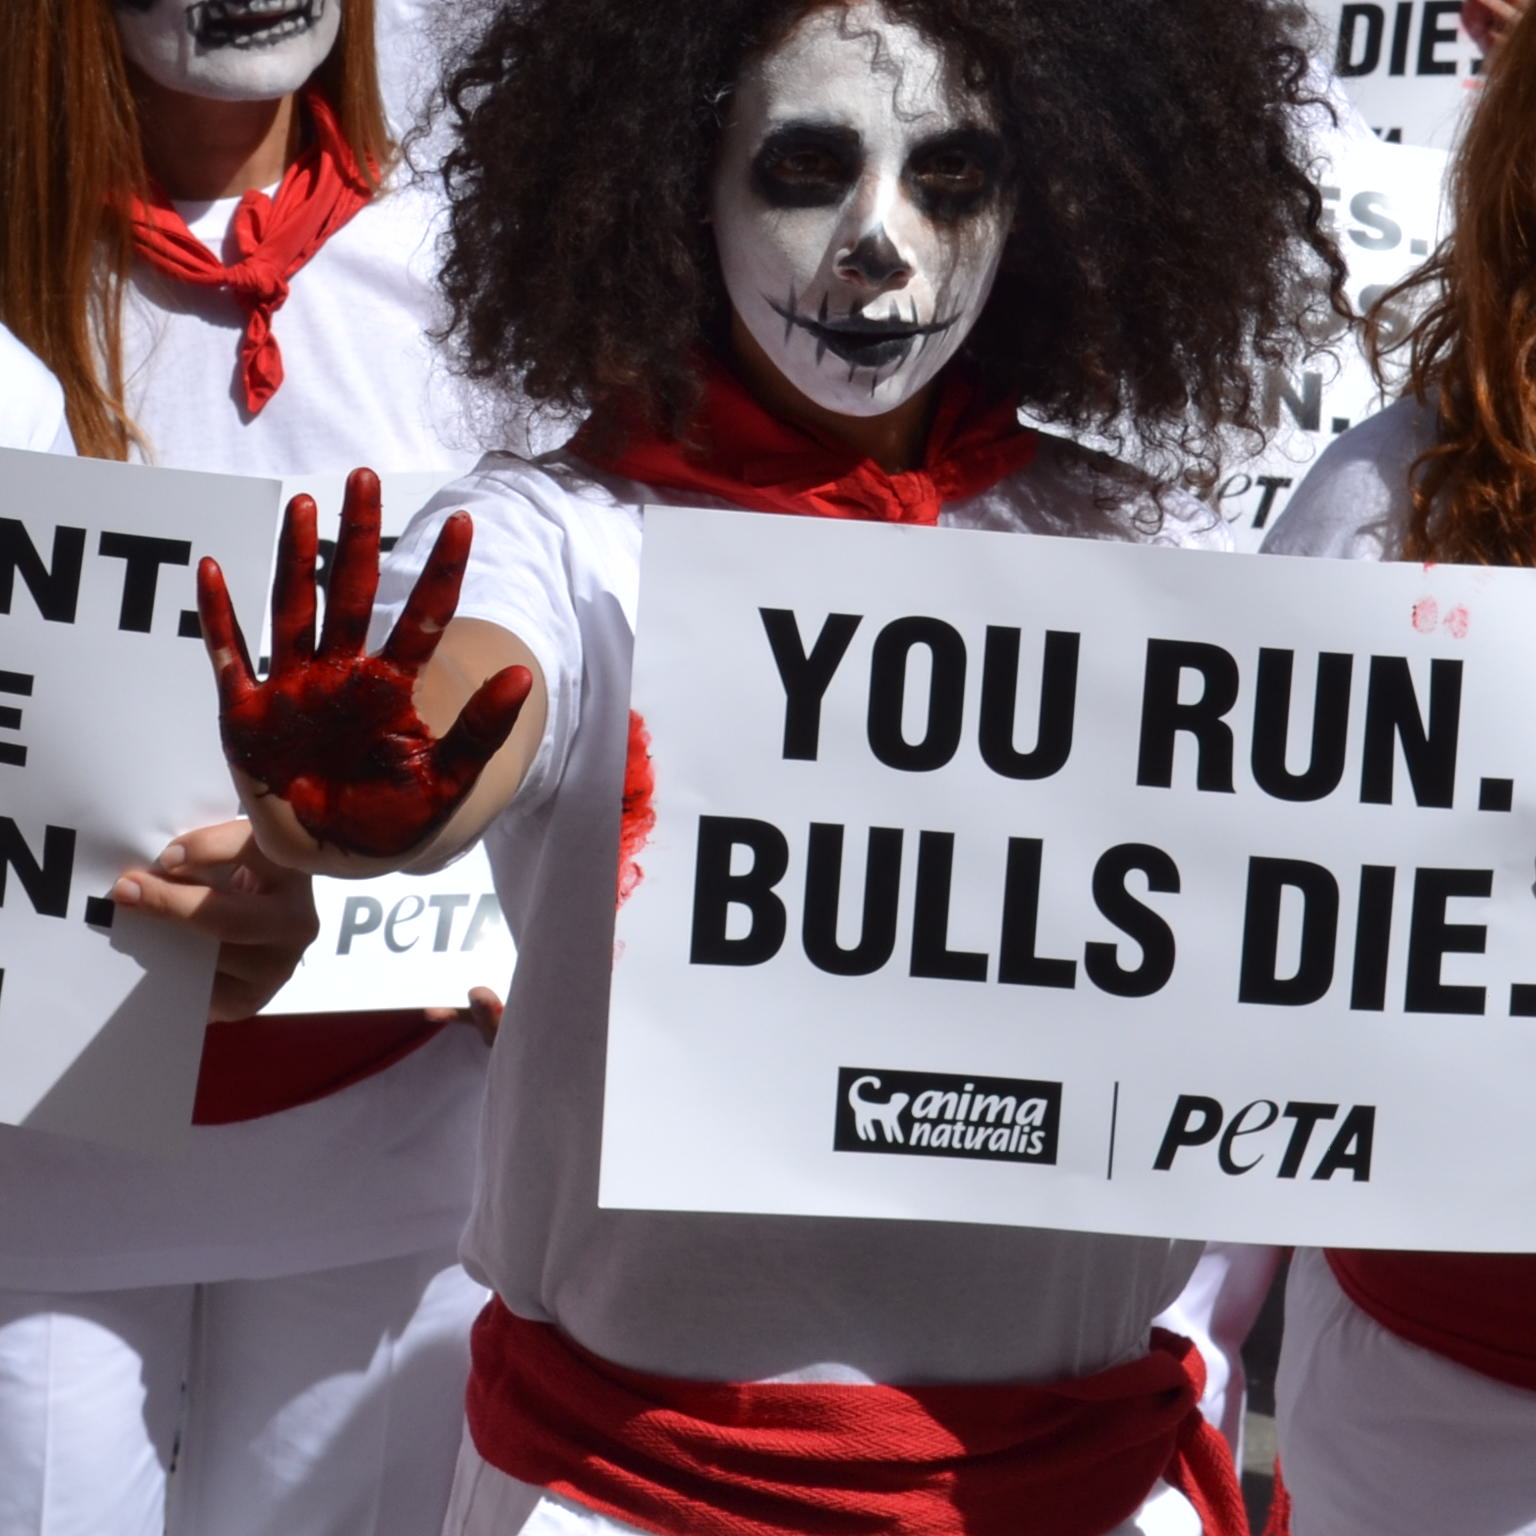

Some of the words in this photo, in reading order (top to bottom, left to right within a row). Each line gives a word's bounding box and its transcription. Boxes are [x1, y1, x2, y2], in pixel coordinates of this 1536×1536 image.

[757, 605, 1082, 781] YOU
[1136, 637, 1515, 814] RUN.
[689, 813, 1182, 999] BULLS
[908, 1081, 1048, 1126] anima
[908, 1118, 1046, 1157] naturalis
